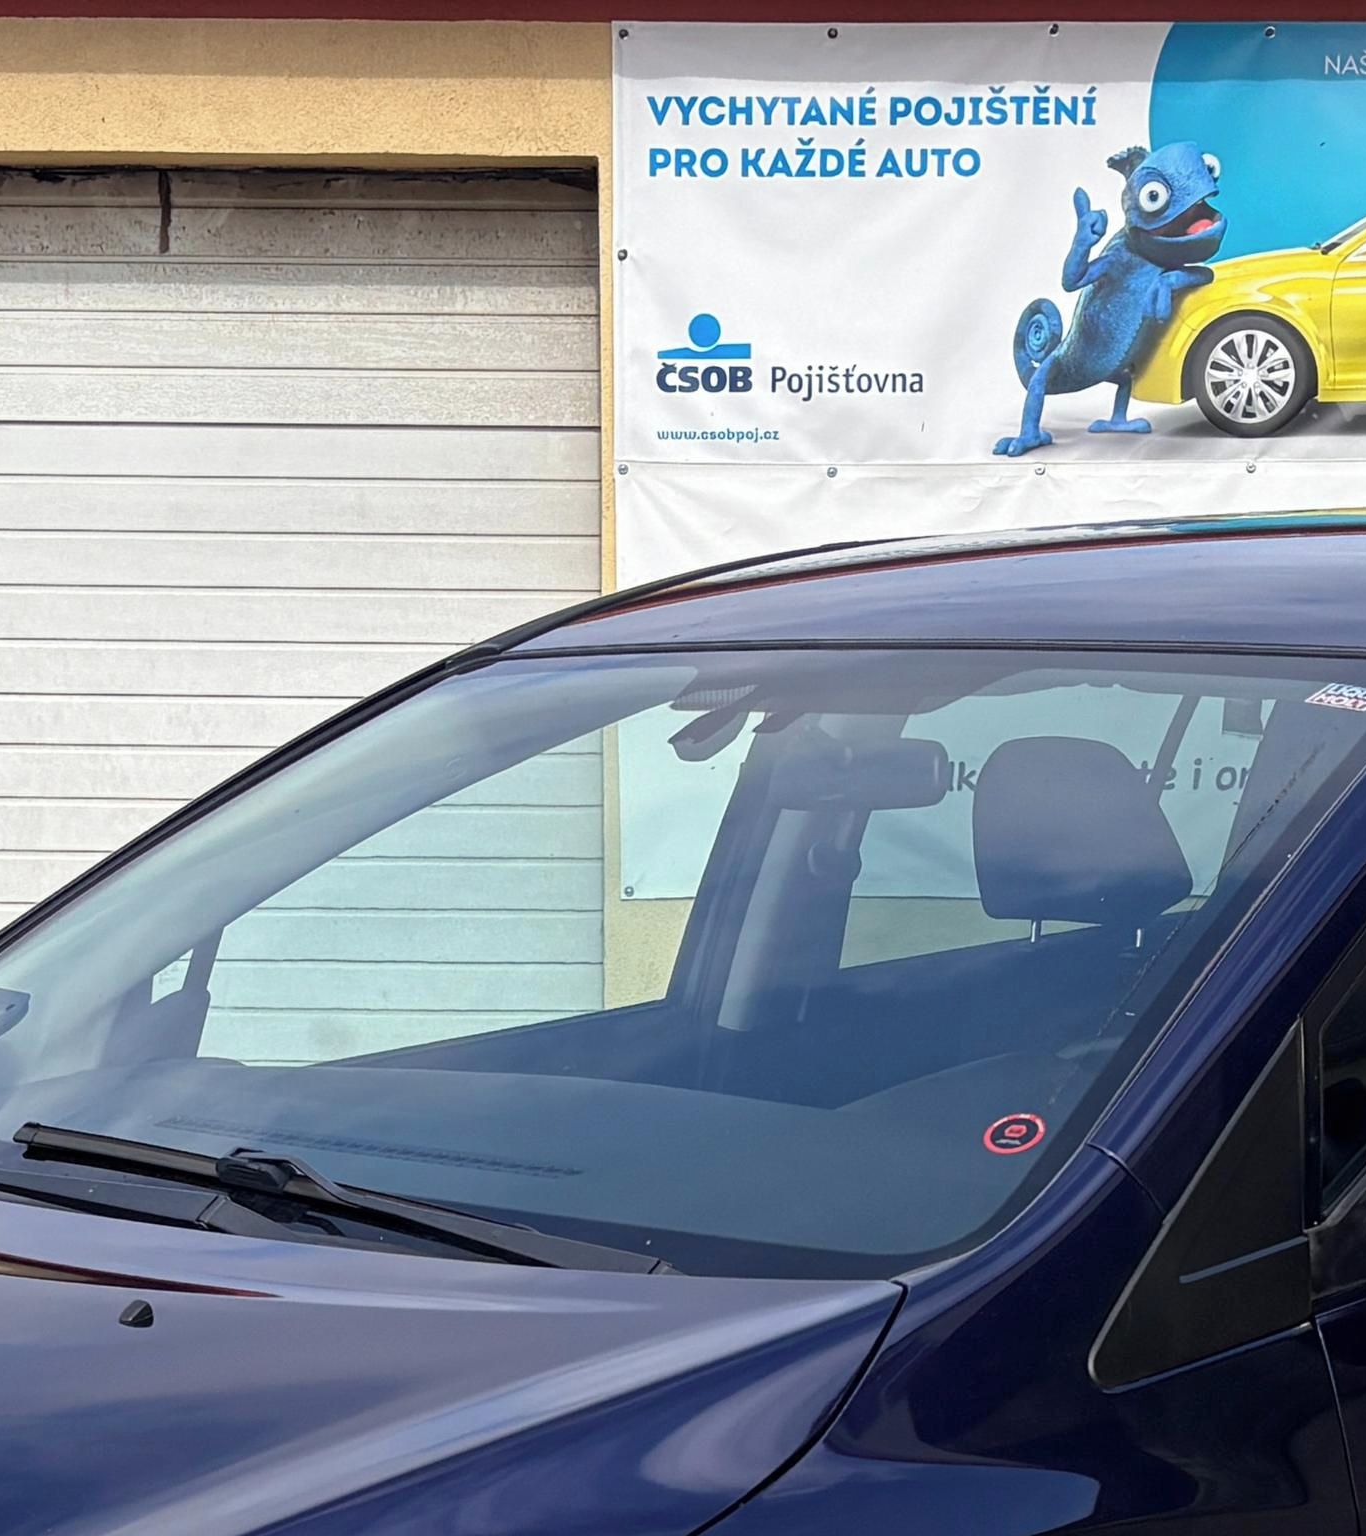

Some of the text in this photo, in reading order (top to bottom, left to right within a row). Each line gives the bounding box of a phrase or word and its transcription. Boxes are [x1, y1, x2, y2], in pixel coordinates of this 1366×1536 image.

[647, 85, 1097, 126] VYCHYTANÉ POJIŠTĚNÍ
[648, 137, 981, 178] PRO KAŽDÉ AUTO
[656, 362, 924, 401] ČSOB Pojišťovna
[656, 428, 780, 443] www.csobpoj.cz
[1192, 758, 1202, 790] i
